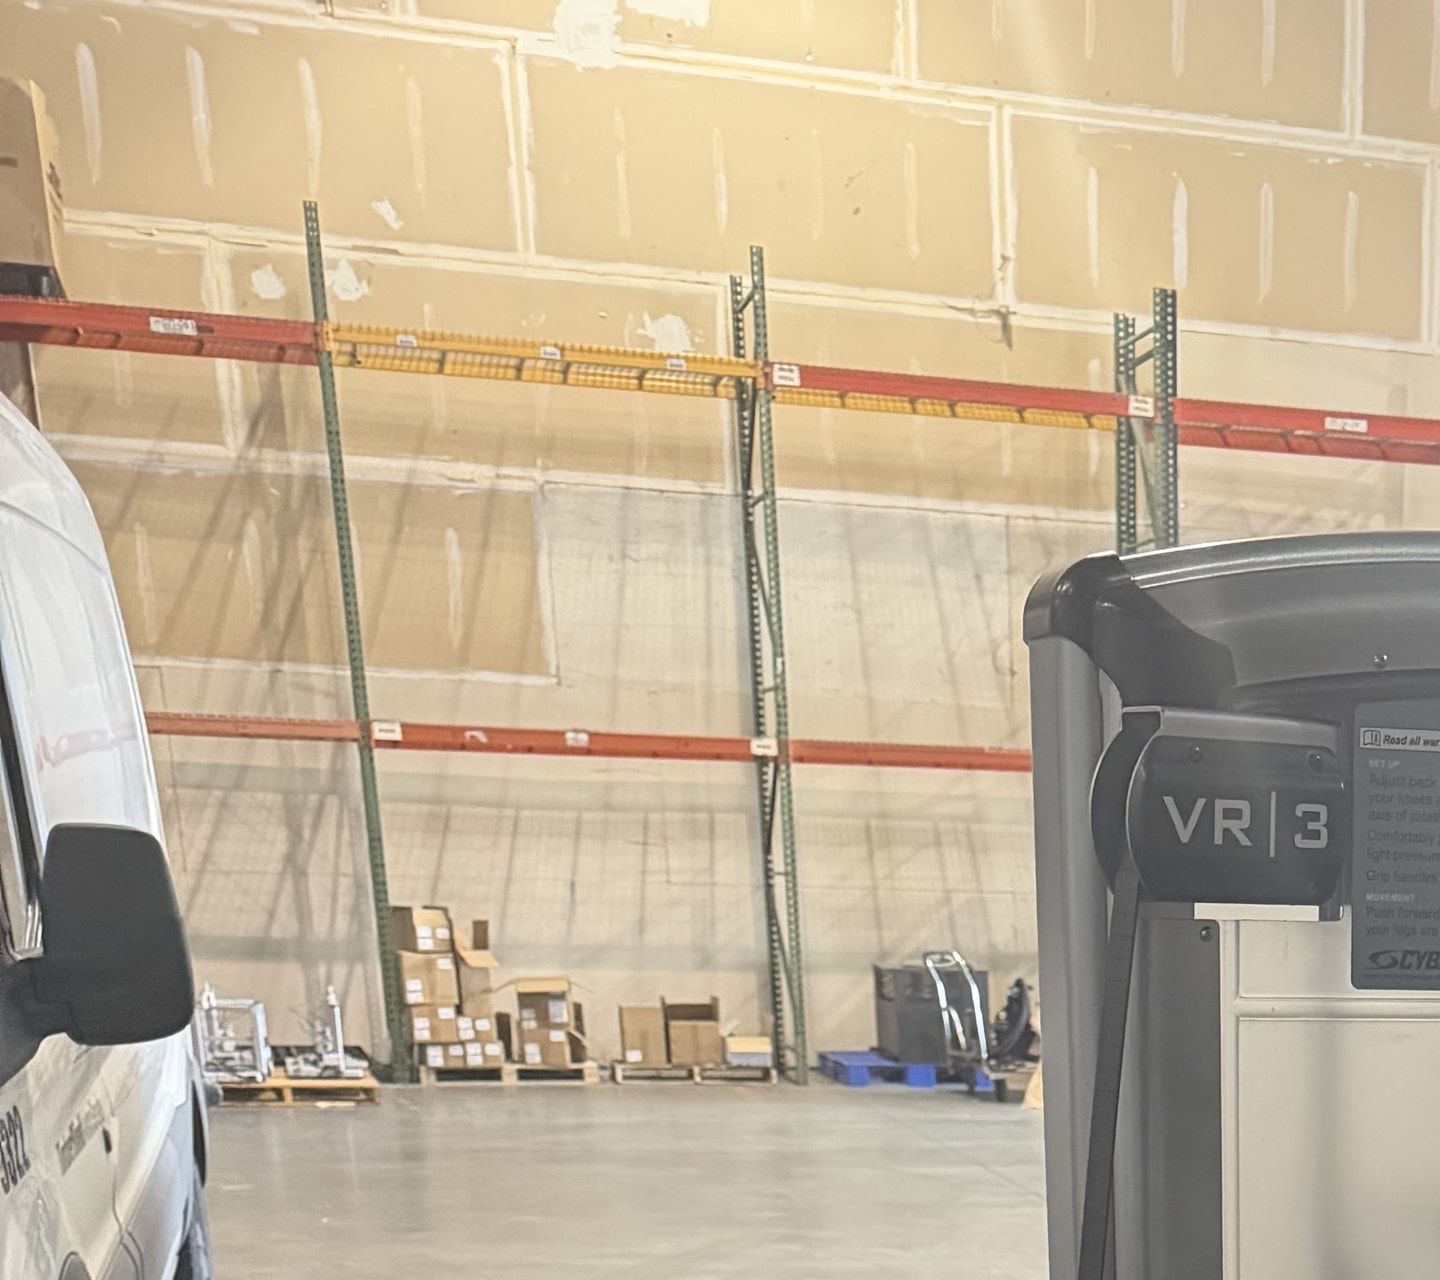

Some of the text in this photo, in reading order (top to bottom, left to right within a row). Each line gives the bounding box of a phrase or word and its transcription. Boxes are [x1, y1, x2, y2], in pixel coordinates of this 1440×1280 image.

[1382, 734, 1407, 746] Read
[1408, 736, 1421, 746] all
[1368, 793, 1394, 806] your
[1395, 809, 1408, 822] of
[1366, 869, 1391, 882] Grip
[1366, 905, 1394, 918] Push
[1365, 925, 1391, 937] your
